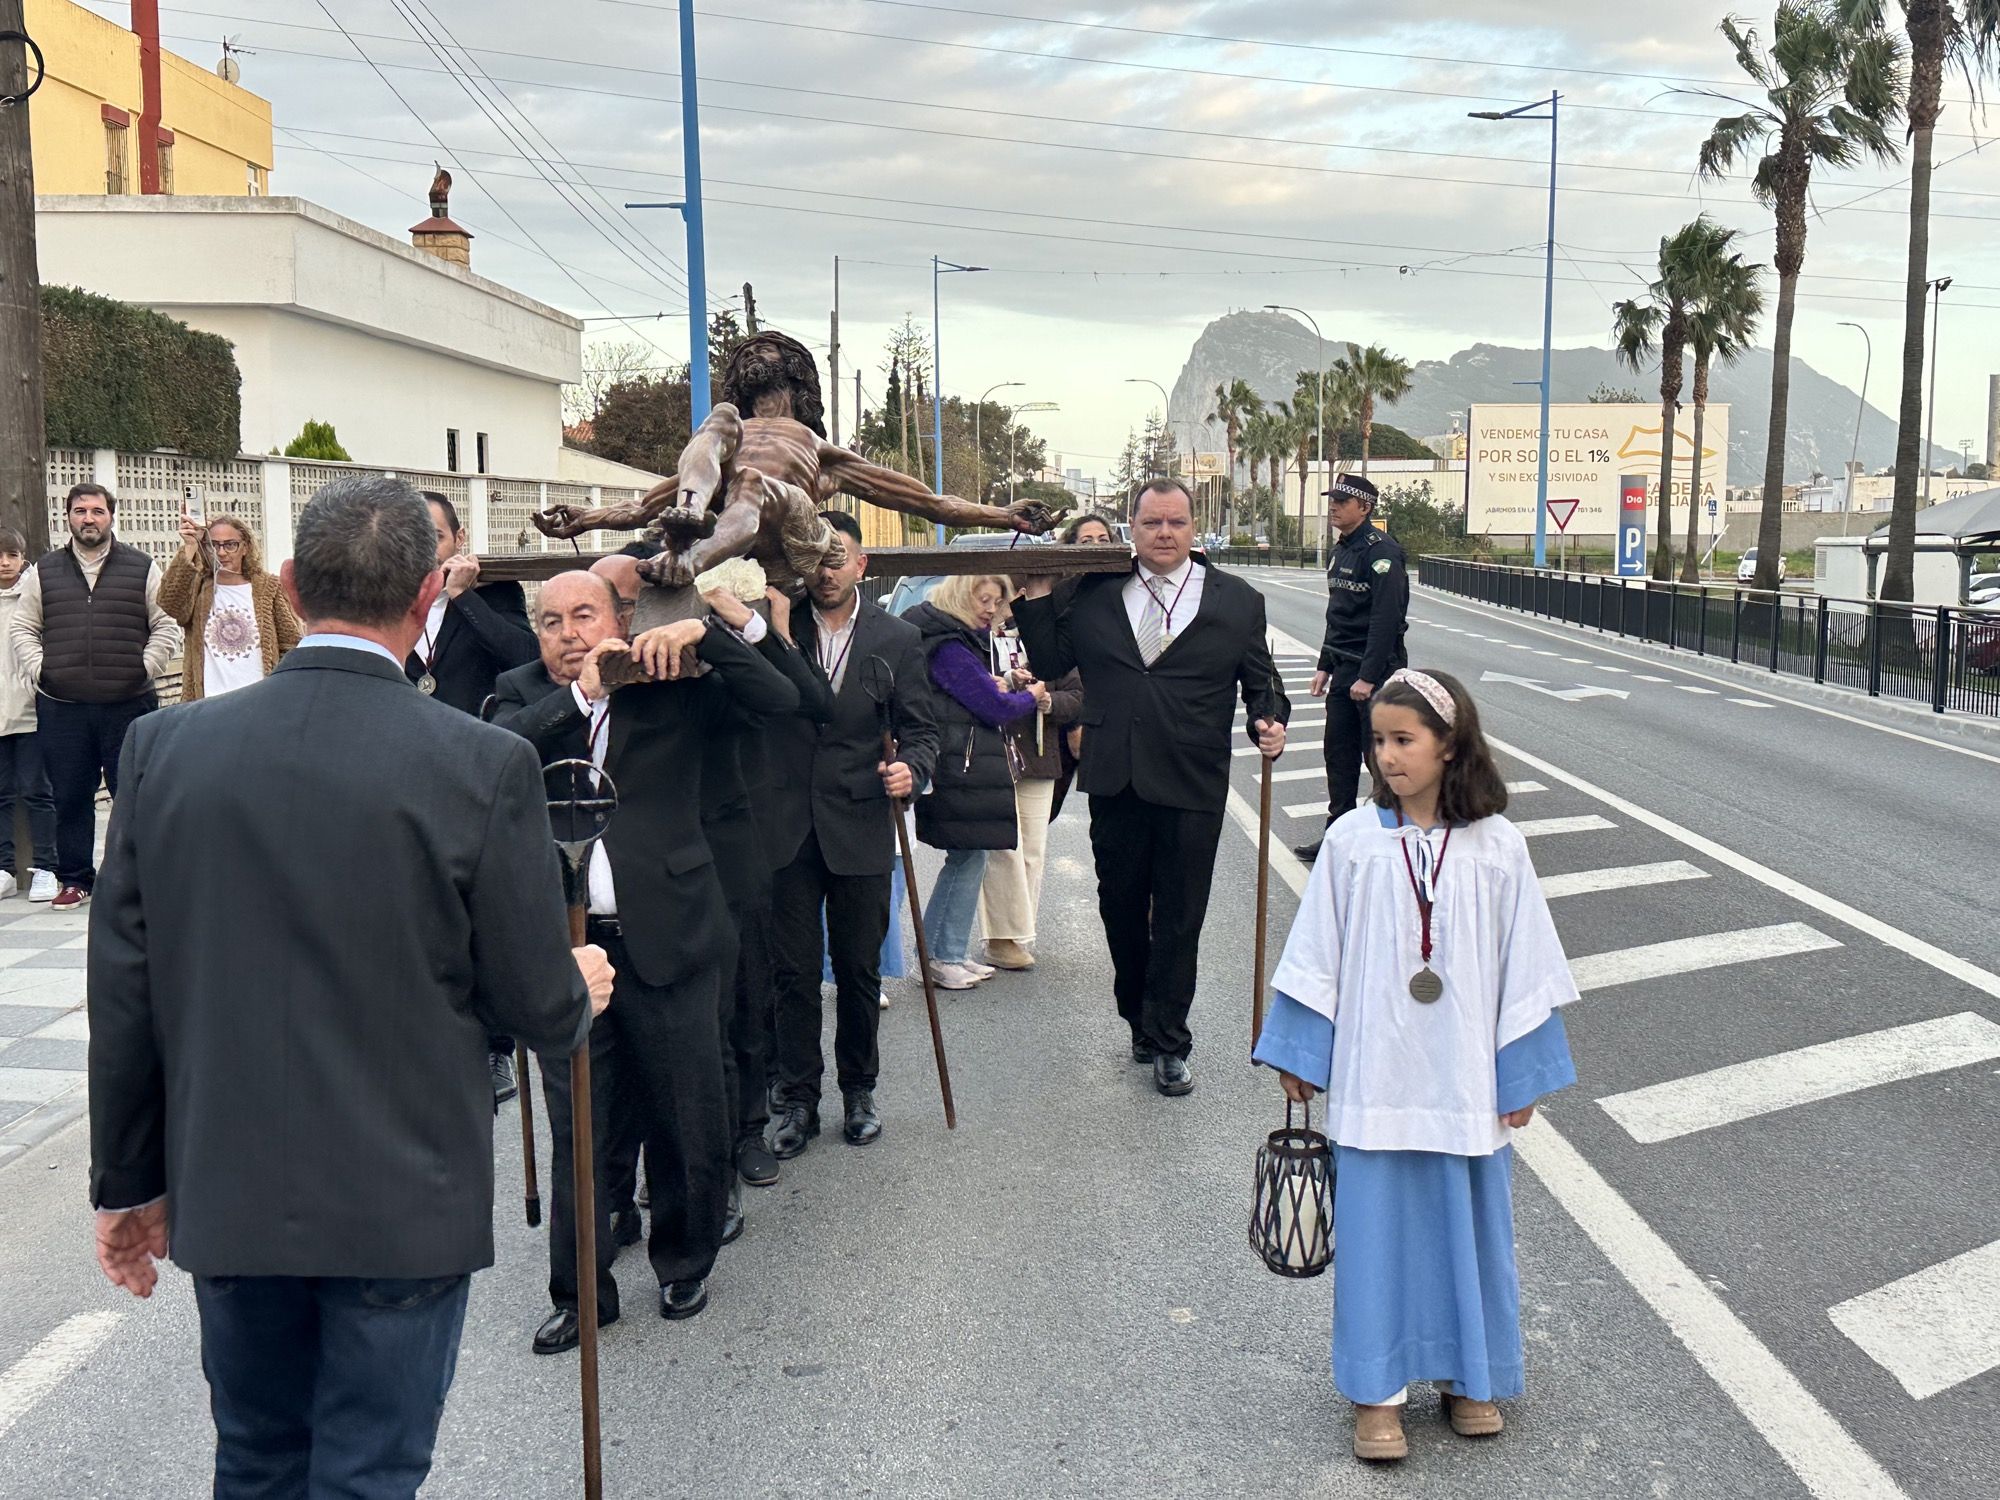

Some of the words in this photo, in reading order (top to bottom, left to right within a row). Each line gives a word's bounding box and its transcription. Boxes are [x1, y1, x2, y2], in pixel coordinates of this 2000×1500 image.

[1481, 429, 1550, 439] VENDEMO
[1554, 429, 1570, 439] TU
[1574, 429, 1609, 439] CASA
[1479, 450, 1512, 462] POR
[1516, 450, 1560, 462] SOO
[1565, 450, 1584, 462] EL
[1588, 450, 1610, 463] 1%
[1489, 473, 1496, 482] Y
[1498, 473, 1517, 482] SIN
[1520, 473, 1598, 482] EXCUSIVIDAD
[1625, 528, 1641, 559] P
